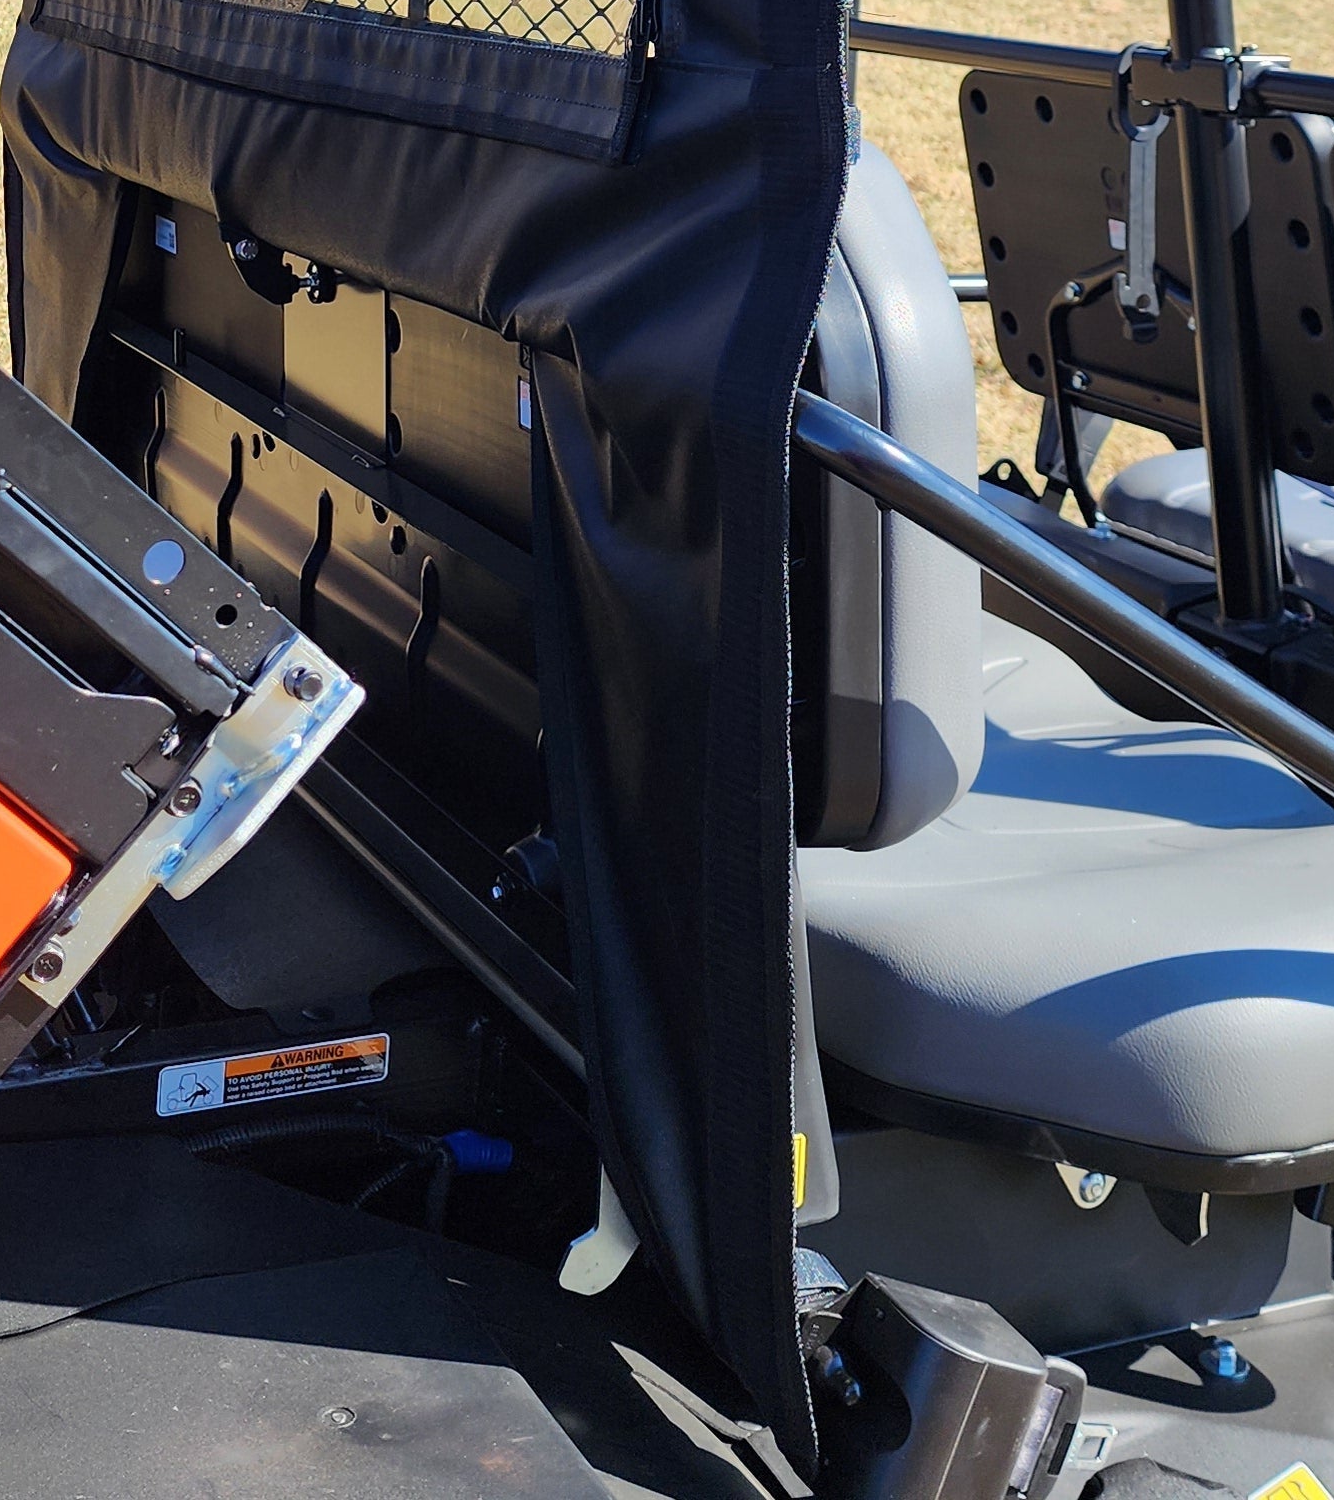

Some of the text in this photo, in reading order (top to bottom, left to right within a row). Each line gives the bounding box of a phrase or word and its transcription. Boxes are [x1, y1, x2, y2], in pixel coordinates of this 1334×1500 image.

[284, 1045, 344, 1064] WARNING
[228, 1077, 239, 1085] TO
[239, 1073, 263, 1084] AVOID
[264, 1067, 304, 1080] PERSONAL
